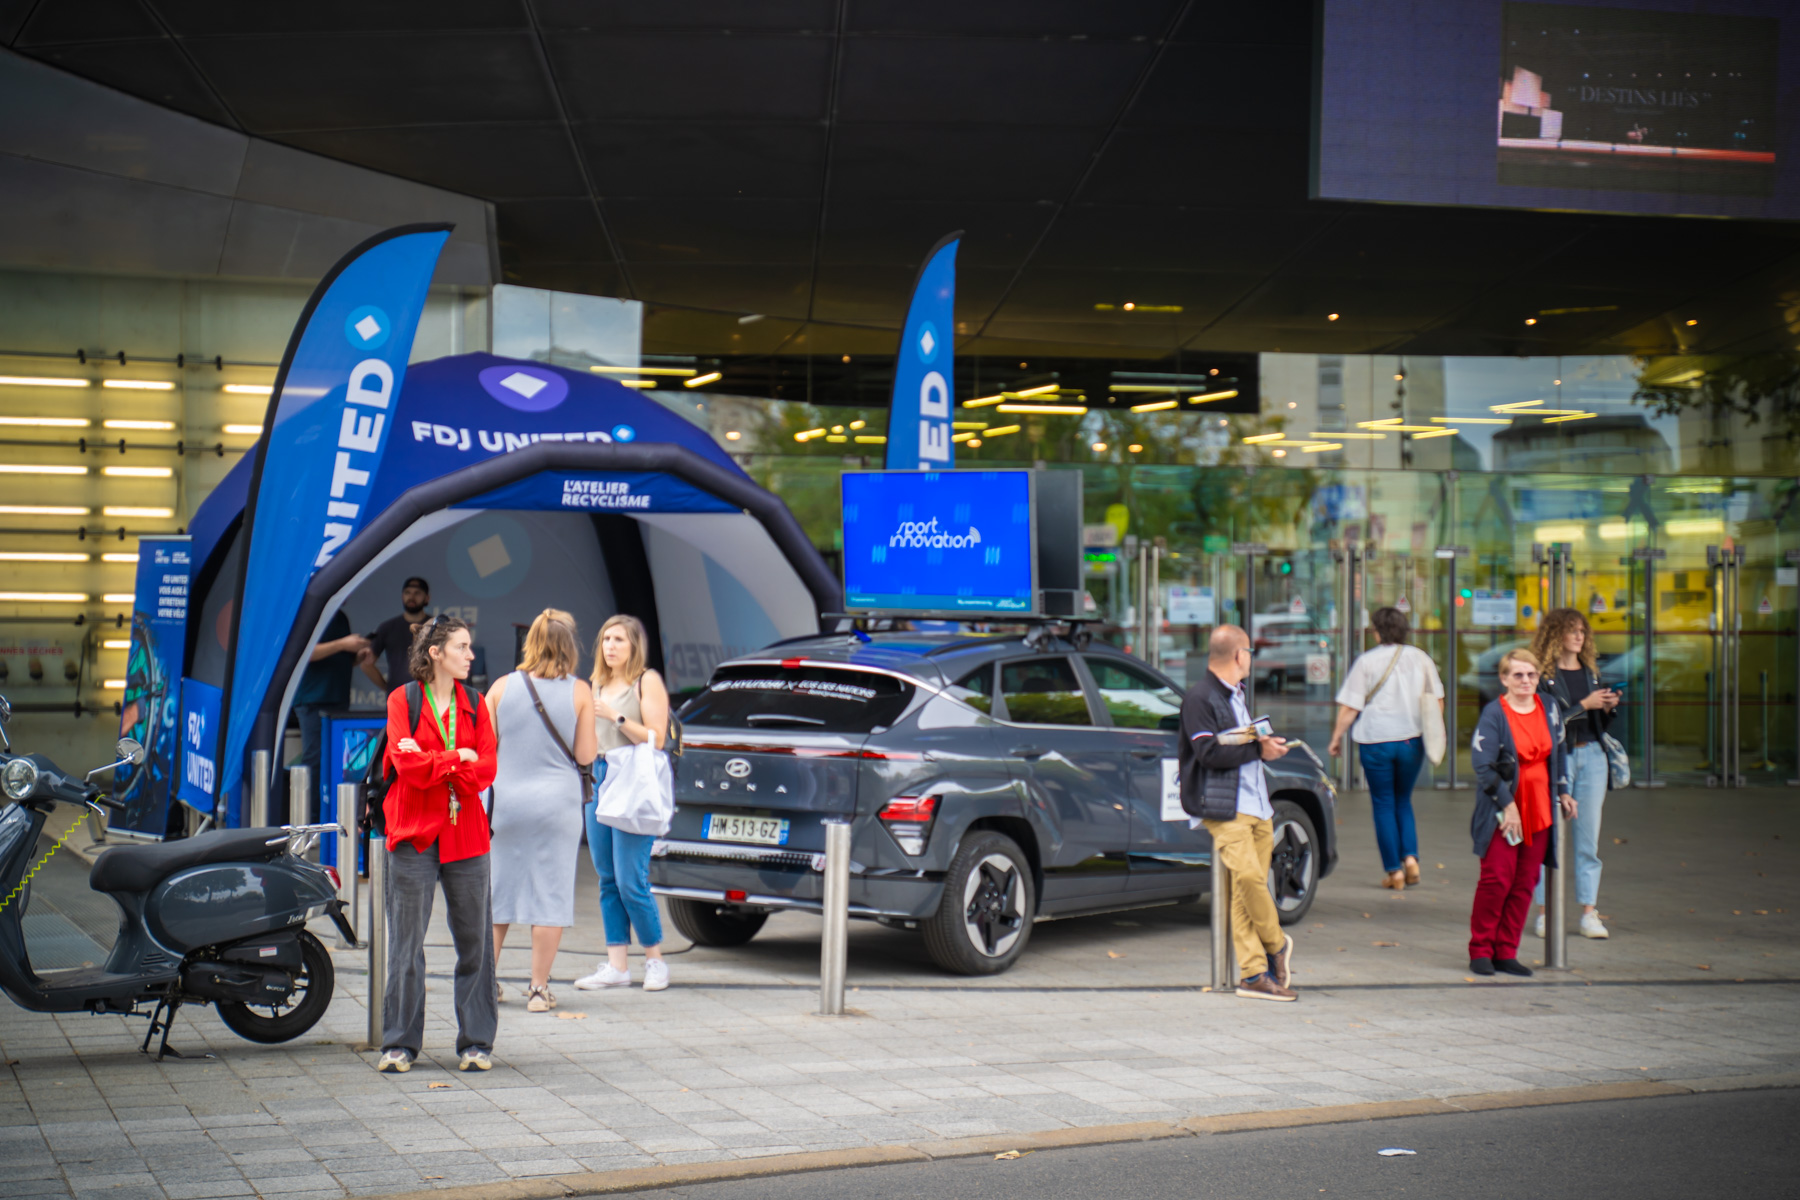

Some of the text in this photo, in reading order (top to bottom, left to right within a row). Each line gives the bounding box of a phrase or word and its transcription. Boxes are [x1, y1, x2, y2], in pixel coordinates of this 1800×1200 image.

[1580, 85, 1656, 106] DESTINS
[411, 420, 472, 451] FDJ
[314, 357, 394, 570] NITED
[563, 480, 630, 495] L'ATELIER
[561, 493, 650, 508] RECYCLISME
[896, 516, 938, 537] sport
[889, 530, 975, 549] innovation
[159, 586, 171, 596] VOUS
[187, 711, 201, 750] FDJ
[186, 751, 215, 795] UNITED
